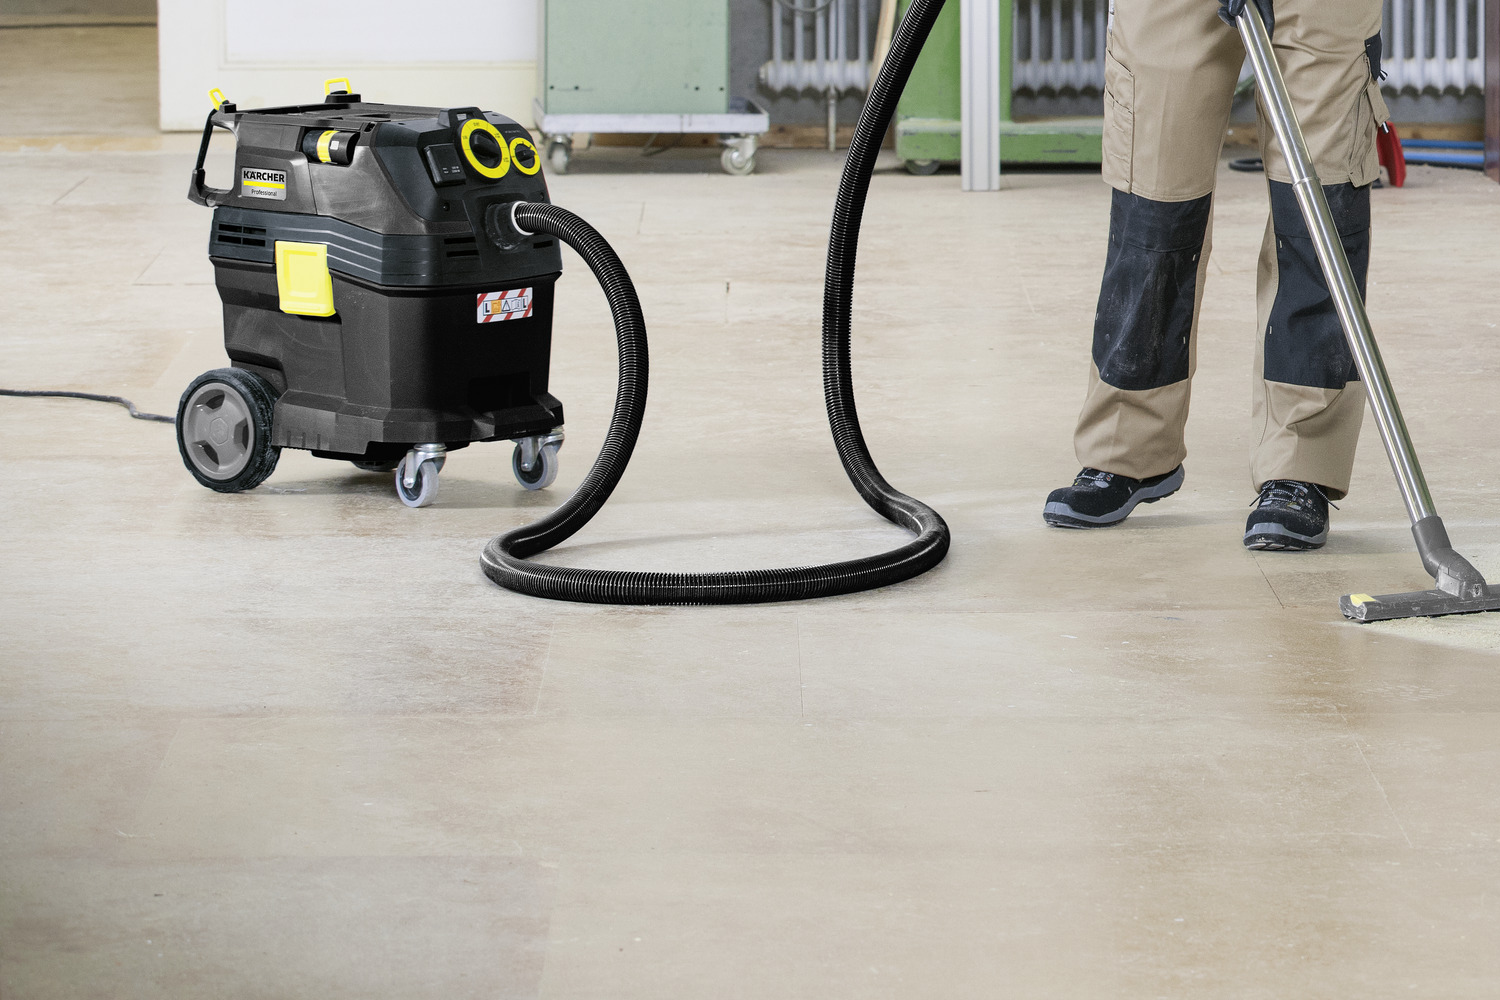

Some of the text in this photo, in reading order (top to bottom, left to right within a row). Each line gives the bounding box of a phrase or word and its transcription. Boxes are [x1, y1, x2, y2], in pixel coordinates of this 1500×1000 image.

[243, 170, 285, 183] KÄRCHER
[251, 188, 278, 197] Professional
[484, 297, 527, 313] L L
